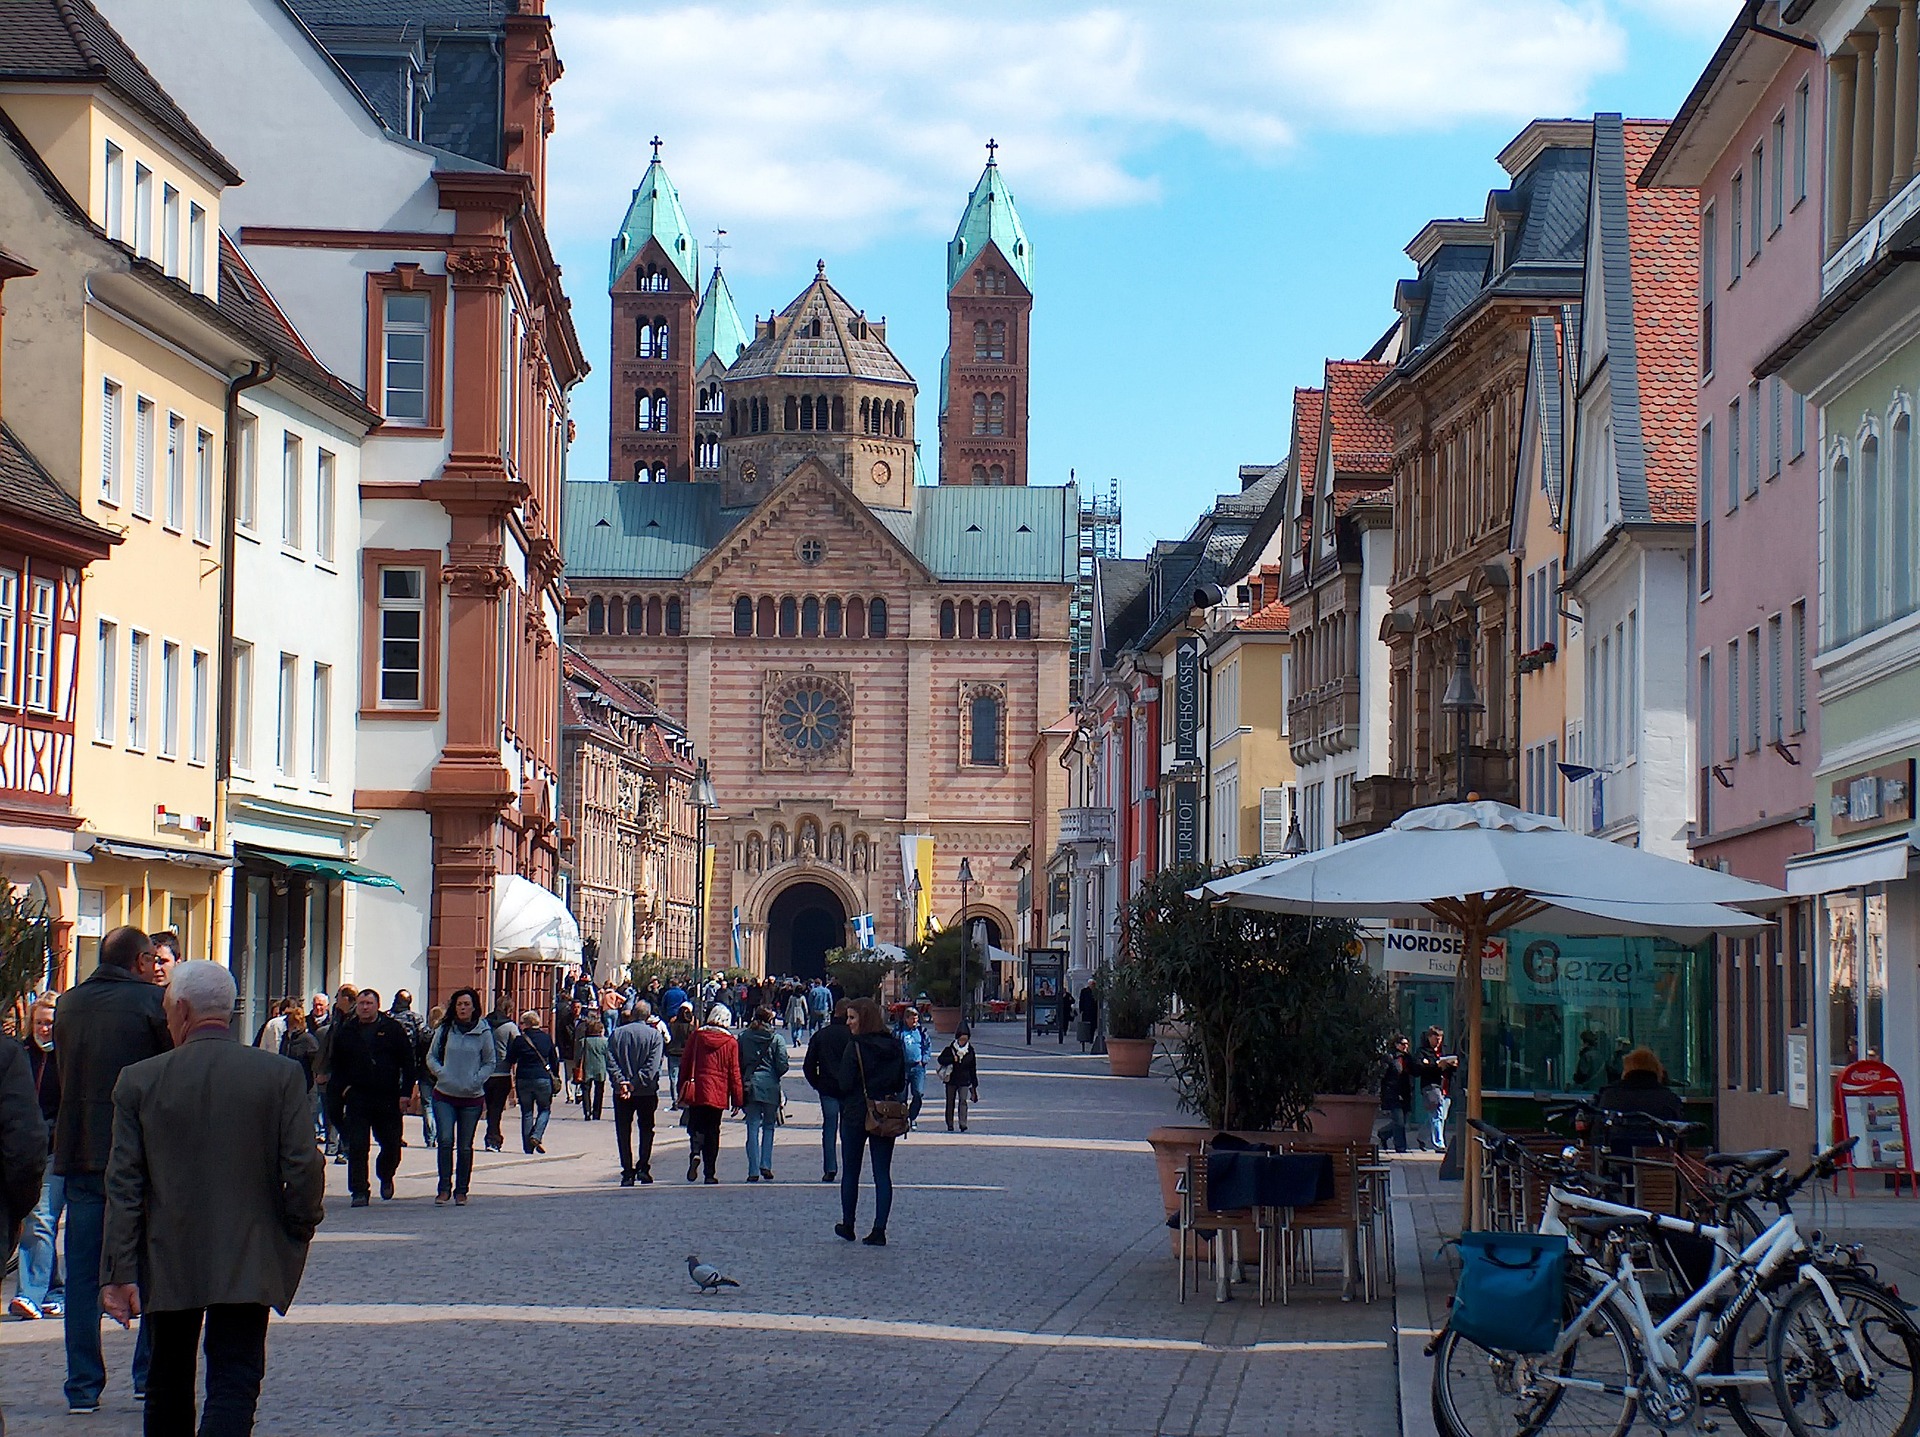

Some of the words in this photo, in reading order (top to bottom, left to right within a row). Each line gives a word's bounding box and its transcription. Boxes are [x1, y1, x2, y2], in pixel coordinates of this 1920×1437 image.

[1179, 661, 1193, 754] FLACHSGASSE
[1179, 799, 1193, 867] TURHOF
[1388, 933, 1468, 955] NORDSE
[1429, 958, 1456, 972] Fisch
